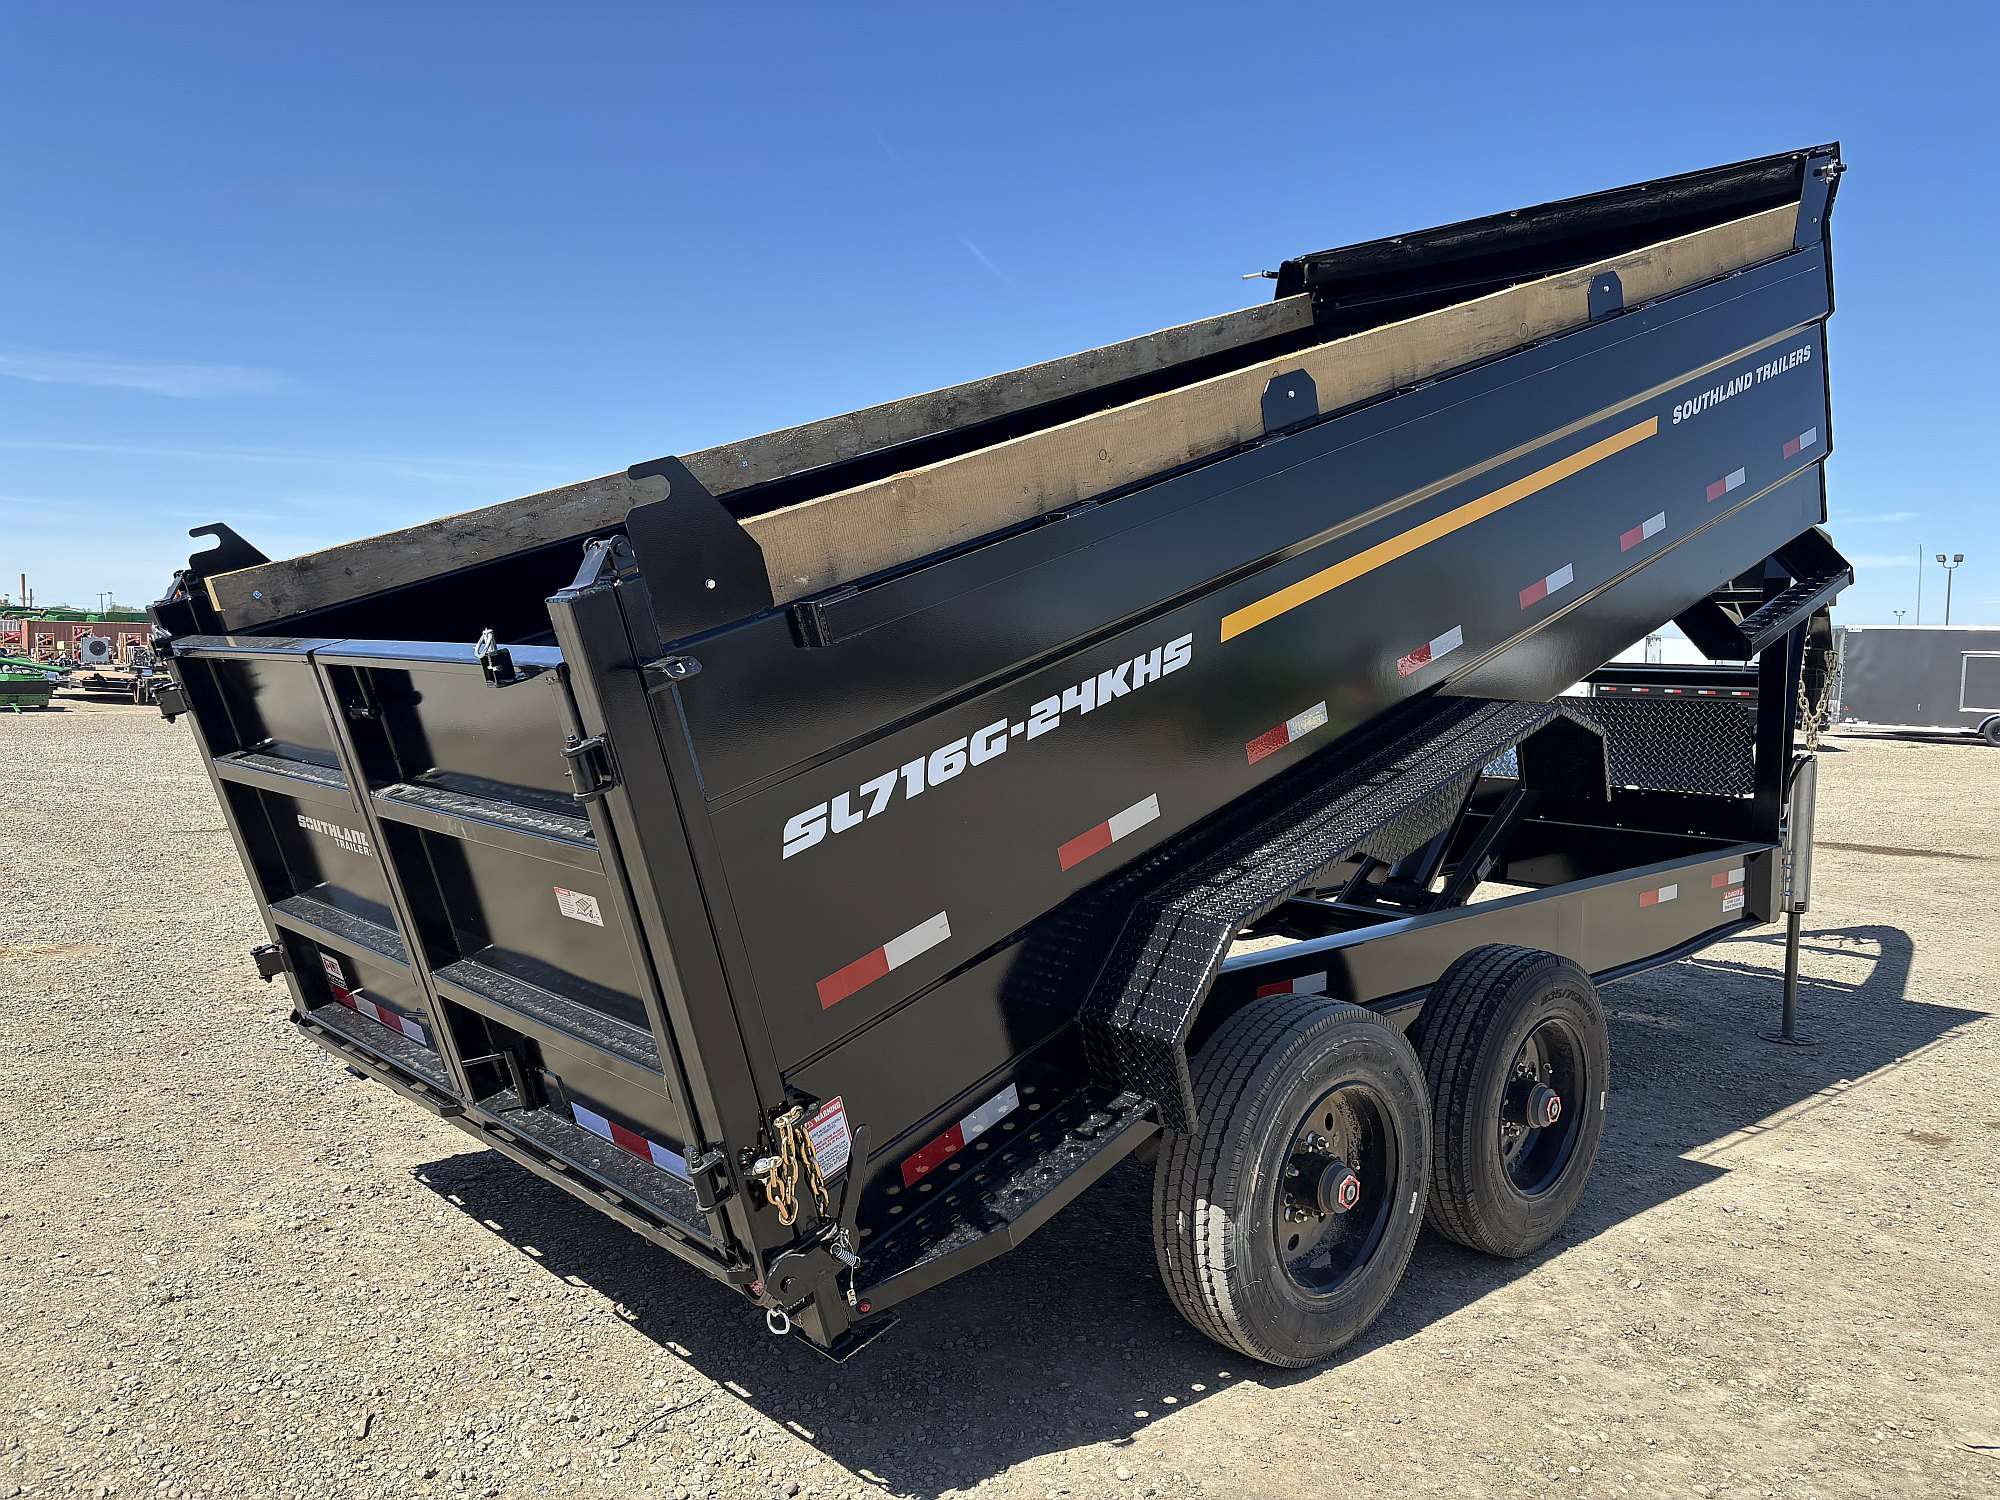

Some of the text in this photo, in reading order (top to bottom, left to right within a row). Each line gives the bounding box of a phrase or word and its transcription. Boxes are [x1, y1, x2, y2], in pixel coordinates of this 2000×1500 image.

[1672, 344, 1811, 425] SOUTHLAND TRAILERS
[782, 632, 1193, 860] SL716G-24KHS
[814, 1101, 841, 1123] WARNING
